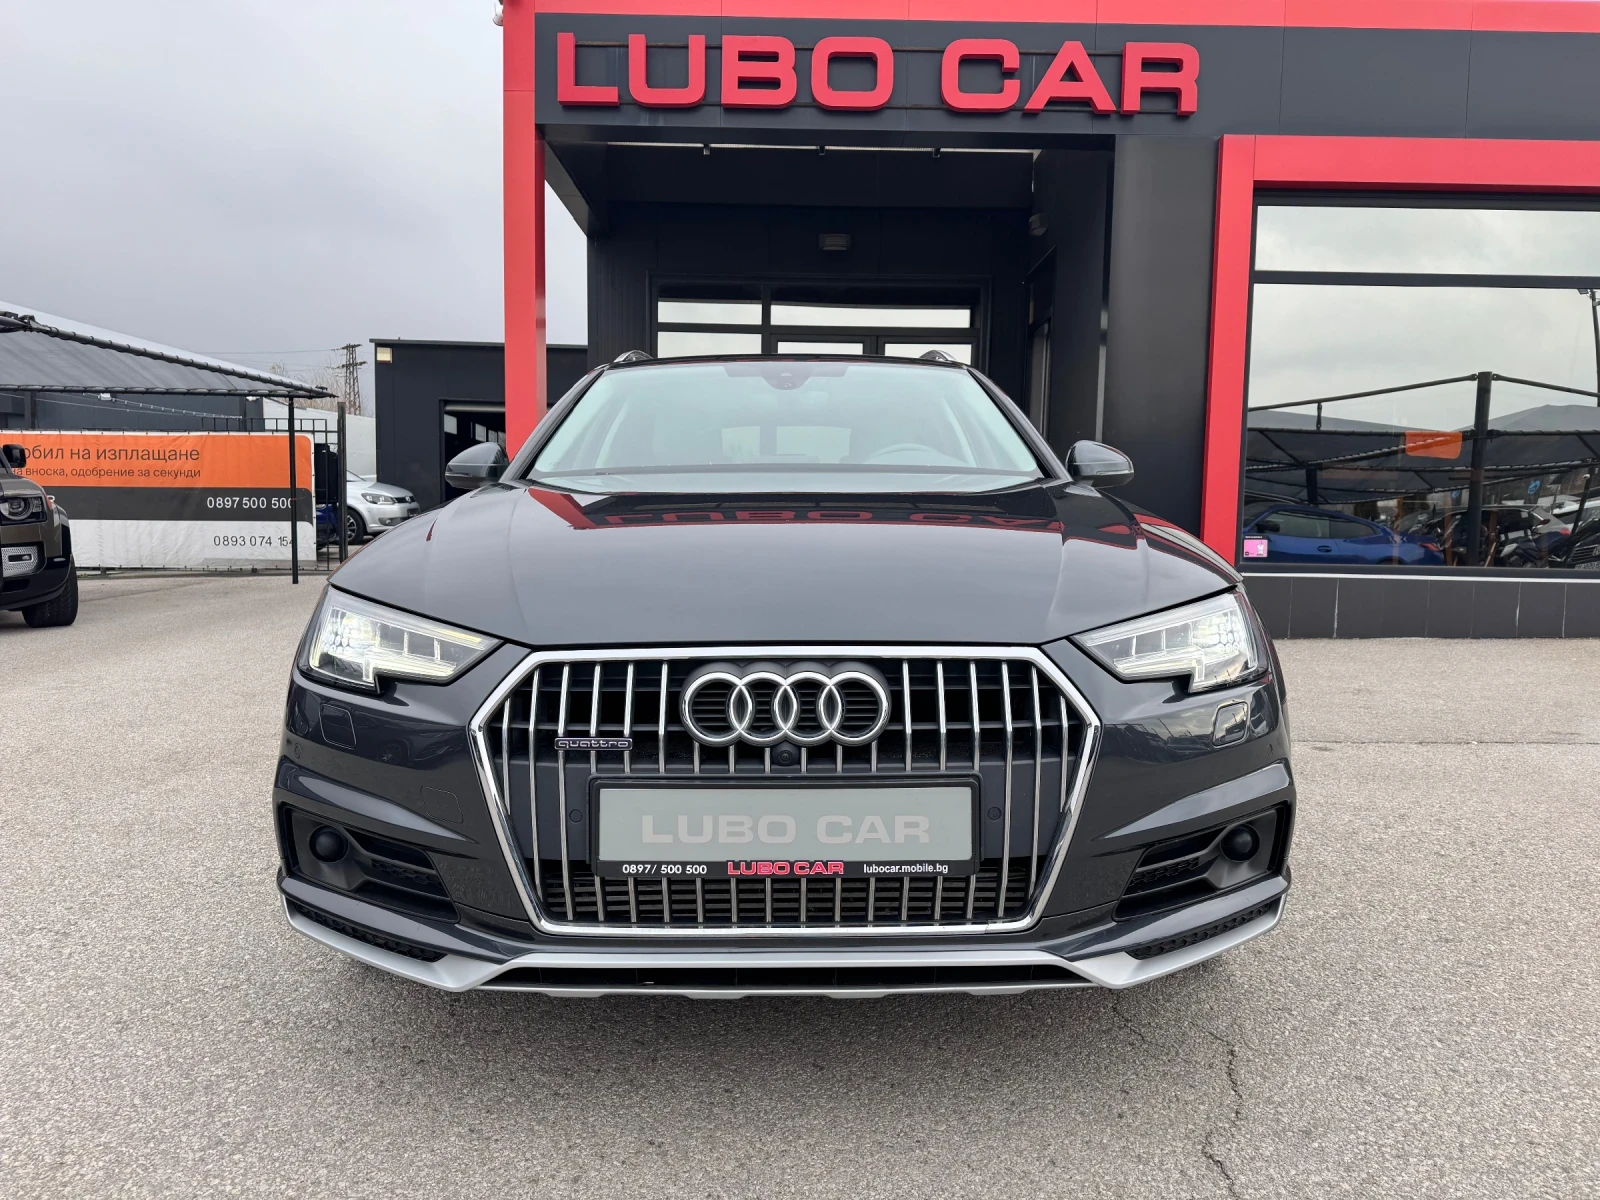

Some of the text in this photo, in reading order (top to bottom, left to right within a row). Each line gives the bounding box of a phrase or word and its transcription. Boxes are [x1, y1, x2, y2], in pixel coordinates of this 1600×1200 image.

[557, 32, 1200, 116] LUBO CAR
[24, 445, 200, 463] обил на изплащане
[26, 468, 68, 477] вноска,
[71, 467, 134, 479] одобрение
[138, 468, 150, 477] за
[153, 468, 201, 479] секунди
[206, 497, 239, 508] 0897
[242, 497, 267, 508] 500
[213, 536, 246, 547] 0893
[249, 536, 272, 547] 074
[558, 740, 629, 749] quattro
[642, 815, 930, 844] LUBO CAR
[622, 864, 708, 875] 0897/ 500 500
[727, 861, 845, 875] LUBO CAR
[863, 863, 949, 874] lubocar.mobile.bg
